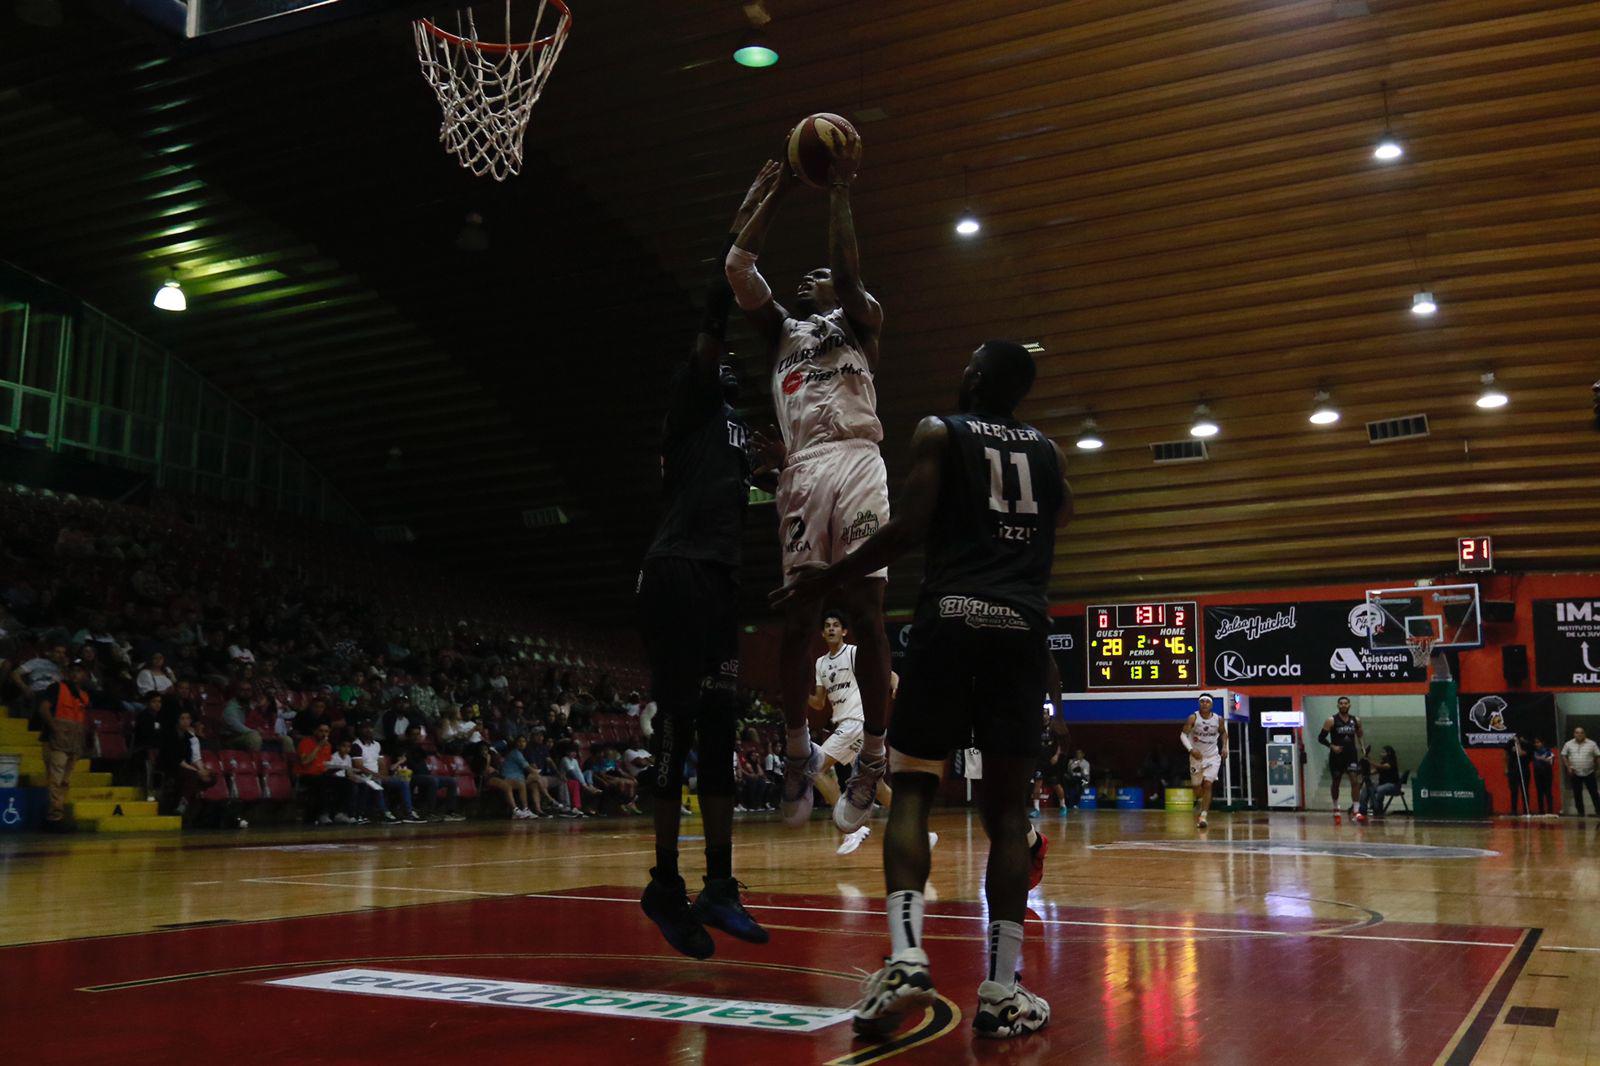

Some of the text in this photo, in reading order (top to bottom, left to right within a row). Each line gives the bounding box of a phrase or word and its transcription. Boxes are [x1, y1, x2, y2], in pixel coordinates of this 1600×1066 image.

[966, 420, 1039, 442] WEBSTER
[984, 447, 1038, 514] 11
[1462, 540, 1488, 560] 21
[1099, 615, 1108, 628] 0
[1175, 611, 1184, 626] 2
[1245, 606, 1296, 640] Huichol
[1102, 638, 1123, 656] 28
[1137, 635, 1146, 648] 2
[1164, 636, 1185, 654] 46
[1221, 653, 1302, 679] Kuroda
[1361, 655, 1408, 663] Asistencia
[1365, 662, 1399, 671] Privada
[1101, 667, 1110, 680] 4
[1150, 665, 1159, 679] 3
[1178, 665, 1188, 679] 5
